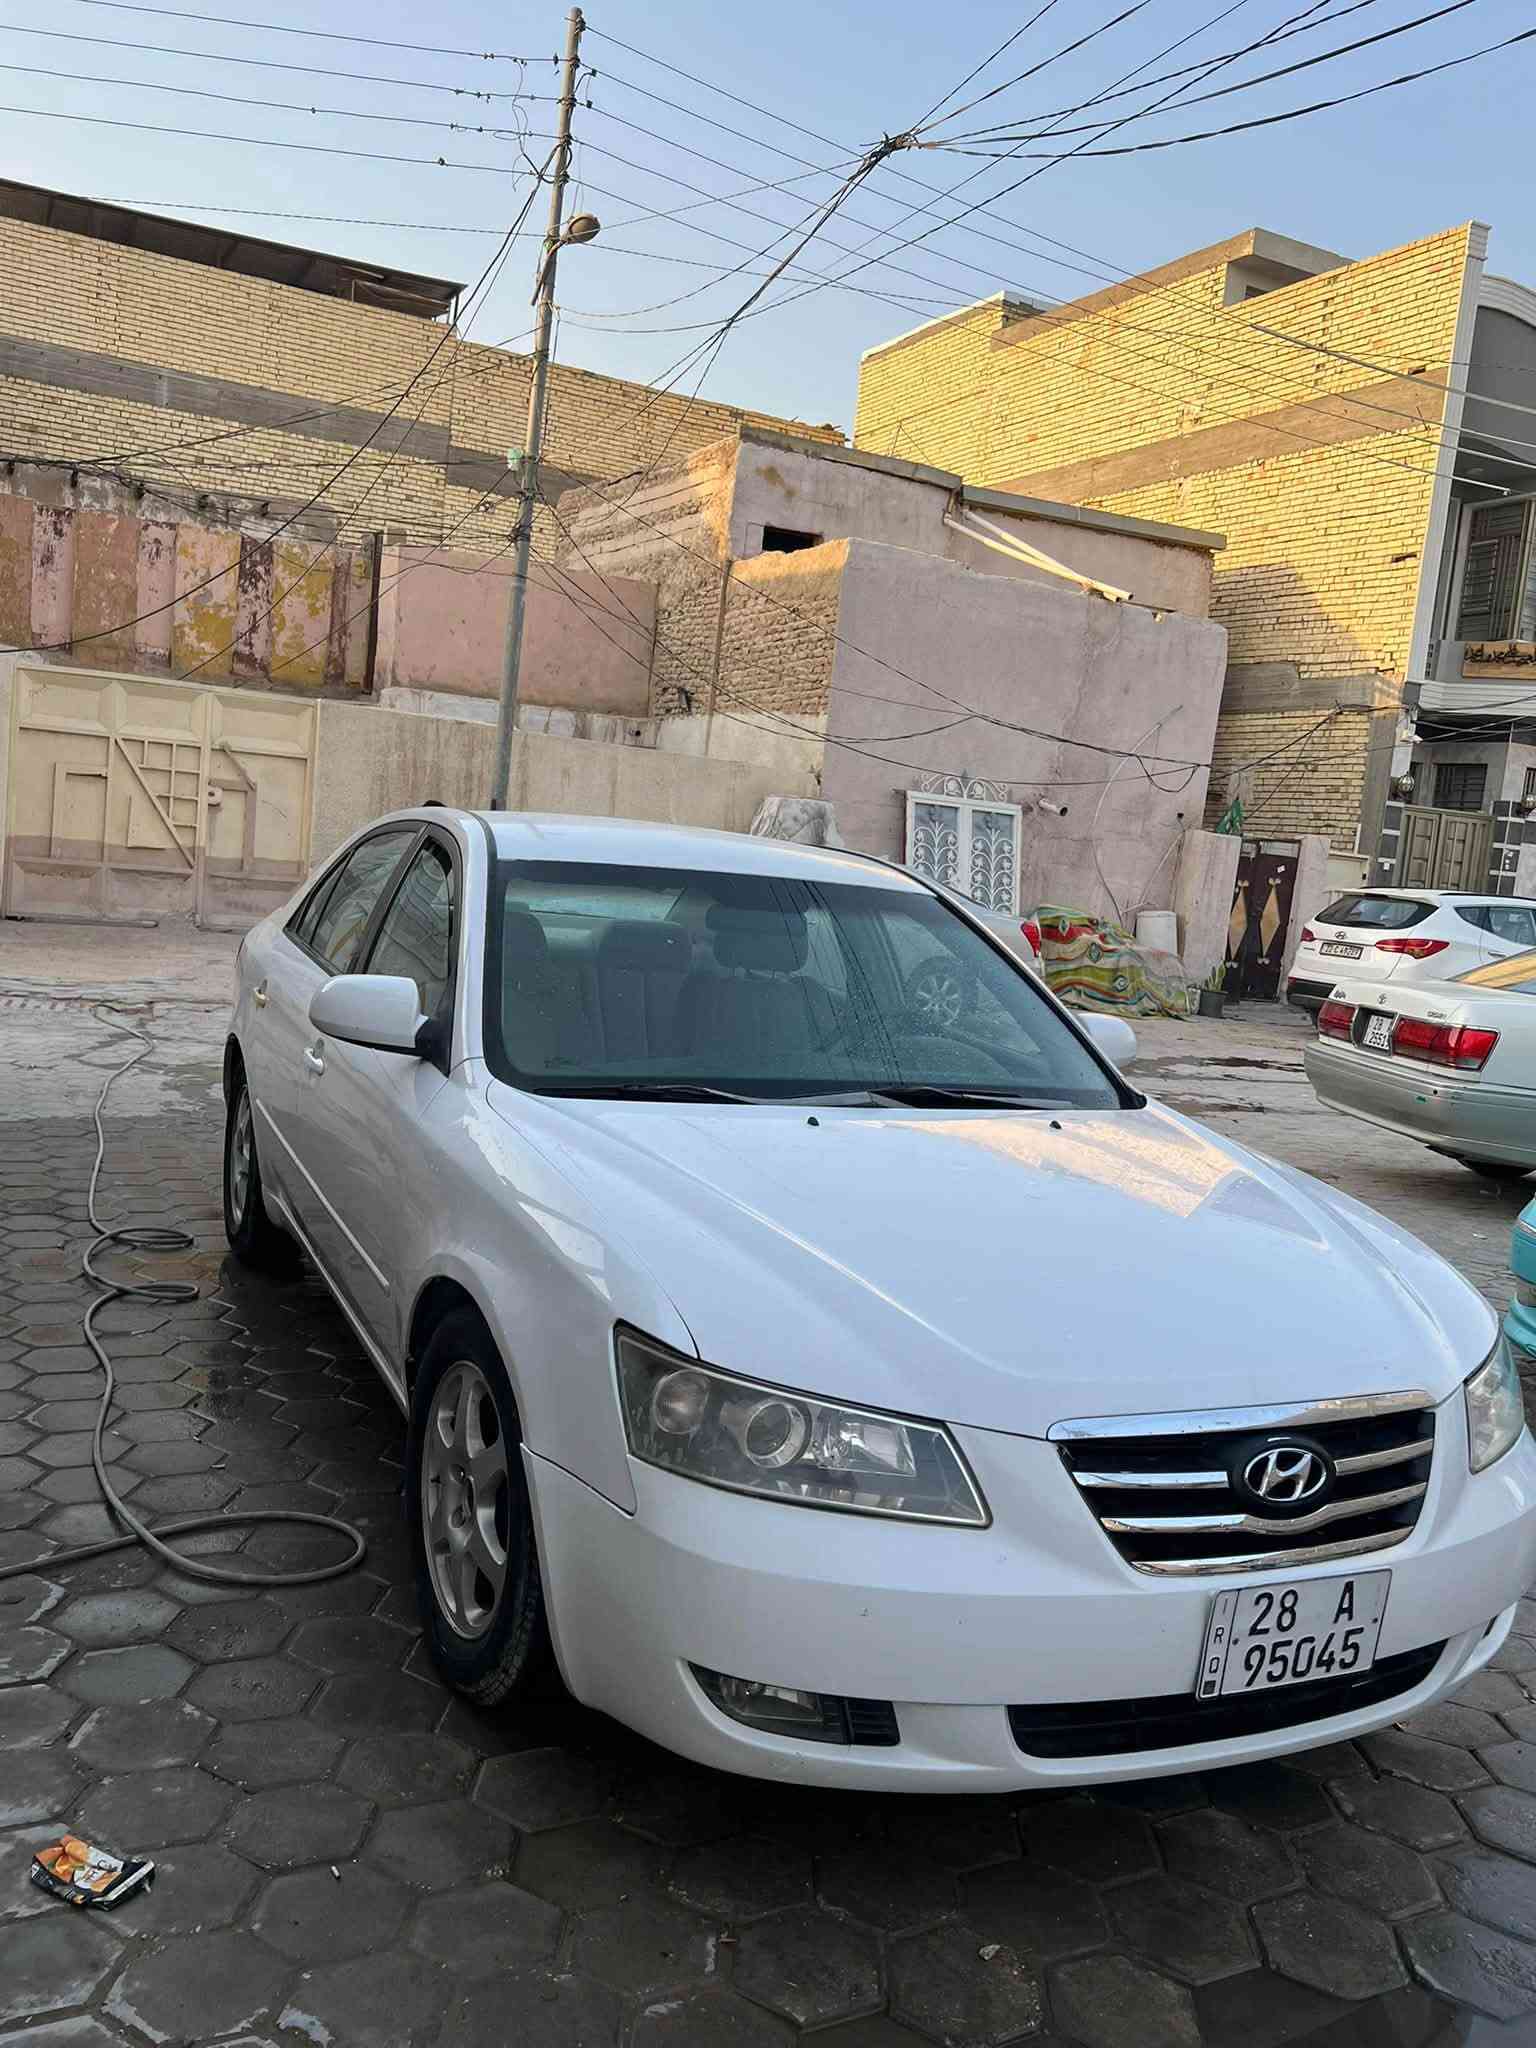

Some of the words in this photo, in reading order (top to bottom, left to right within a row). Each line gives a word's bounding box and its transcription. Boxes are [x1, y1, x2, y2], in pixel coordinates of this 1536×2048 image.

[1248, 1589, 1299, 1637] 28
[1333, 1580, 1355, 1624] A
[1244, 1627, 1365, 1687] 95045
